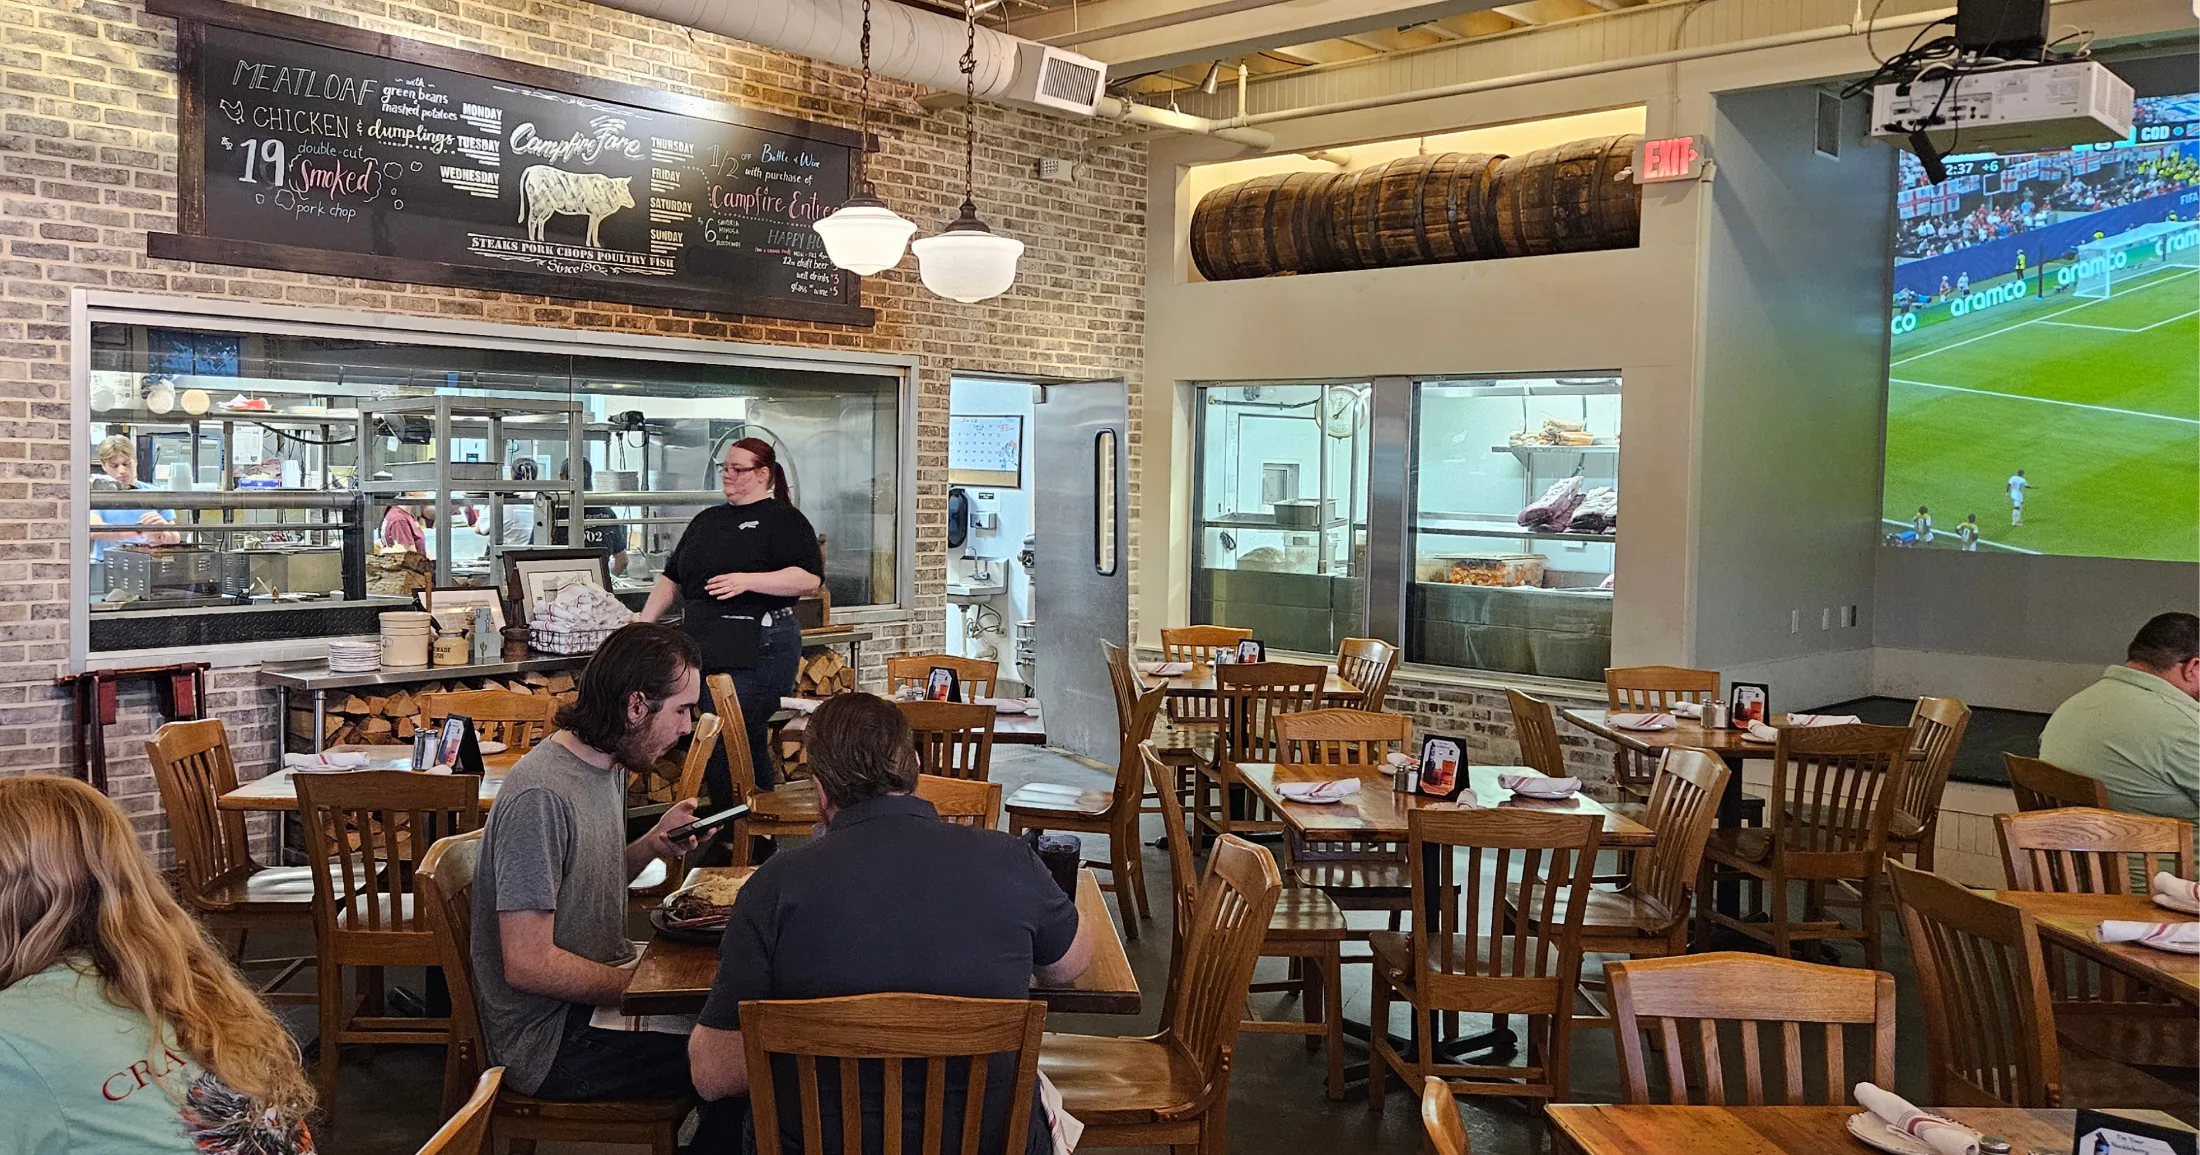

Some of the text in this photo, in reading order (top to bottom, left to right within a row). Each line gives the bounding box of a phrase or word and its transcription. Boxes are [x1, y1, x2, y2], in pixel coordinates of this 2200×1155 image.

[233, 60, 377, 105] MEATLOAF
[405, 77, 425, 87] with
[381, 87, 449, 104] green beans
[381, 103, 458, 121] mashed potatoes
[462, 103, 503, 121] MONDAY
[254, 106, 348, 138] CHICKEN
[367, 118, 454, 153] dumplings
[2141, 125, 2170, 141] COD
[457, 135, 500, 153] TUESDAY
[510, 115, 646, 165] Campfire Fare
[651, 137, 694, 154] THURSDAY
[706, 145, 739, 179] 1/2
[761, 143, 789, 163] Bottle
[800, 152, 820, 168] Wine
[1644, 136, 1693, 179] EXIT
[1982, 160, 1999, 172] +6
[297, 160, 374, 200] Smoked
[440, 166, 499, 184] WEDNESDAY
[651, 168, 681, 182] FRIDAY
[745, 167, 813, 186] with purchase of
[650, 197, 692, 213] SATURDAY
[710, 184, 787, 215] Campfire
[2179, 191, 2199, 205] FIFA
[296, 203, 356, 222] pork chop
[650, 229, 683, 243] SUNDAY
[767, 229, 805, 249] HAPPY
[471, 237, 675, 268] STEAKS PORK CHOPS POULTRY FISH
[547, 259, 608, 276] Since 1902
[796, 257, 813, 269] draft
[814, 259, 829, 270] beer
[2058, 249, 2127, 286] aramco
[796, 271, 808, 280] well
[810, 272, 830, 284] drinks
[791, 282, 808, 294] glass
[813, 288, 828, 297] wine
[1950, 279, 2027, 317] aramco
[584, 531, 602, 542] 02
